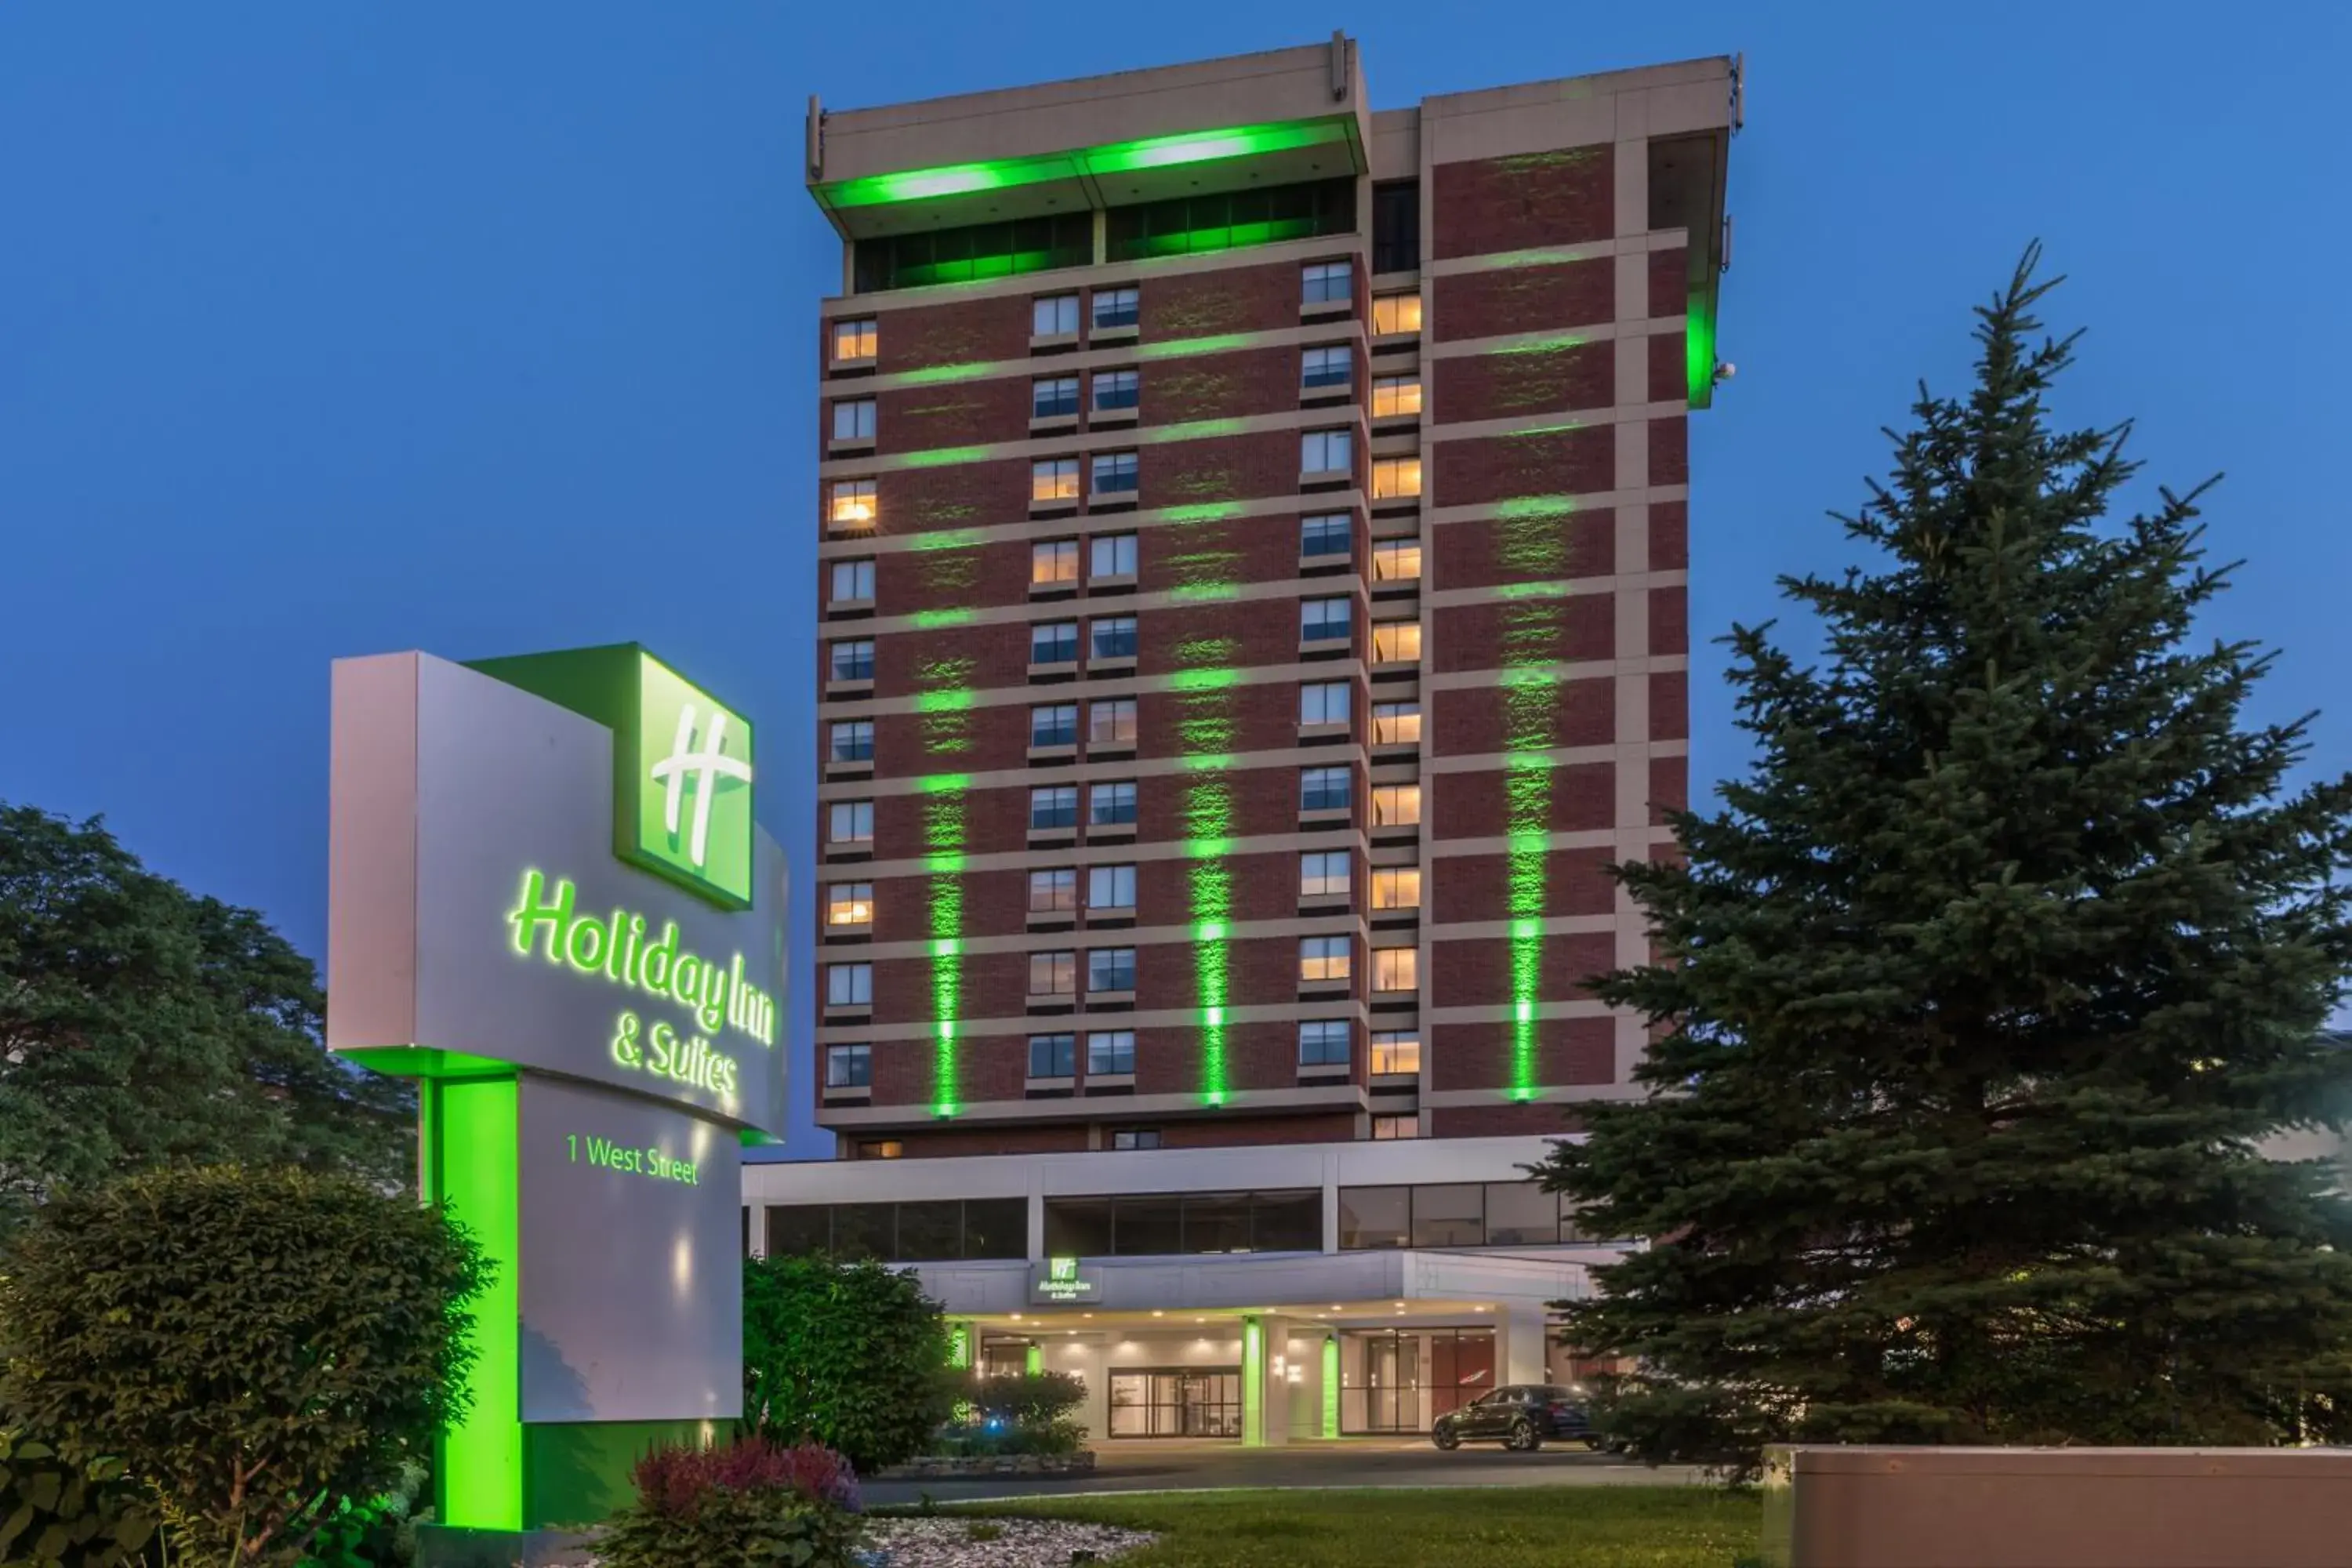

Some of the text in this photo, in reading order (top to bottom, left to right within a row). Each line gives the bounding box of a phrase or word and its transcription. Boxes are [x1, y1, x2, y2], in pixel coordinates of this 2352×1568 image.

[506, 867, 775, 1047] Holiday Inn
[612, 1011, 738, 1091] & Suites
[567, 1134, 699, 1186] 1 West Street
